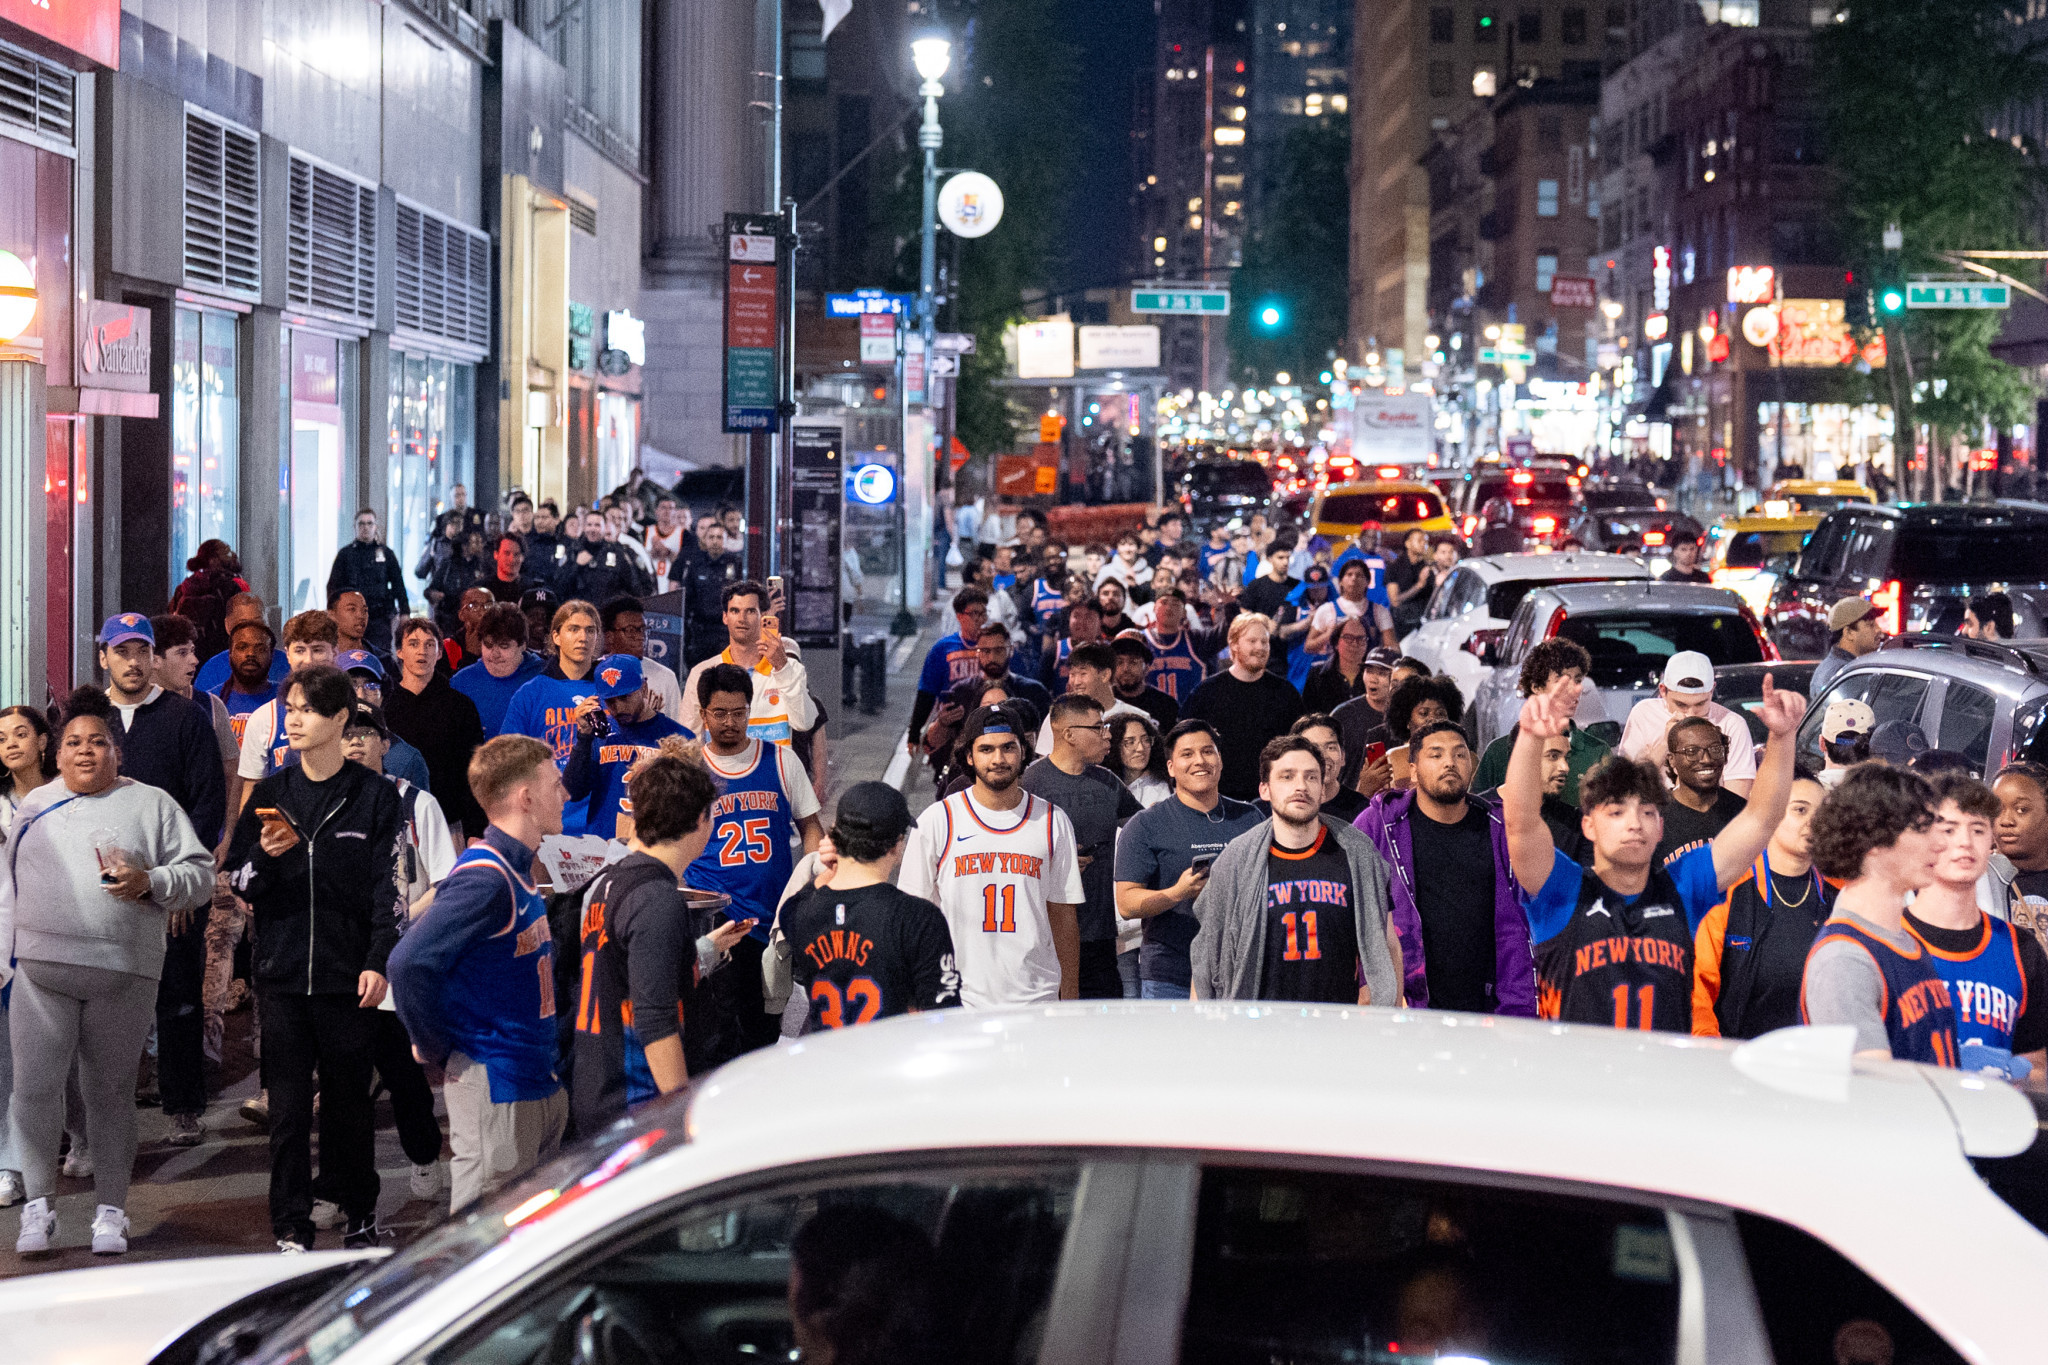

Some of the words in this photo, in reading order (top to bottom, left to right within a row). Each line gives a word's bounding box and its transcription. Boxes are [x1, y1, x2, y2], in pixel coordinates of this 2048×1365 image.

[832, 299, 865, 312] West
[97, 325, 151, 374] Santander
[599, 745, 635, 765] NEW
[713, 793, 739, 818] EW
[735, 791, 779, 812] YORK
[717, 816, 773, 868] 25
[954, 852, 997, 878] NEW
[997, 852, 1044, 881] YORK
[982, 883, 1016, 933] 11
[1294, 879, 1348, 907] YORK
[804, 930, 874, 970] TOWNS
[1281, 910, 1322, 961] 11
[1575, 936, 1630, 977] NEW
[1628, 937, 1686, 976] YORK
[811, 977, 882, 1030] 32
[1611, 983, 1655, 1032] 11
